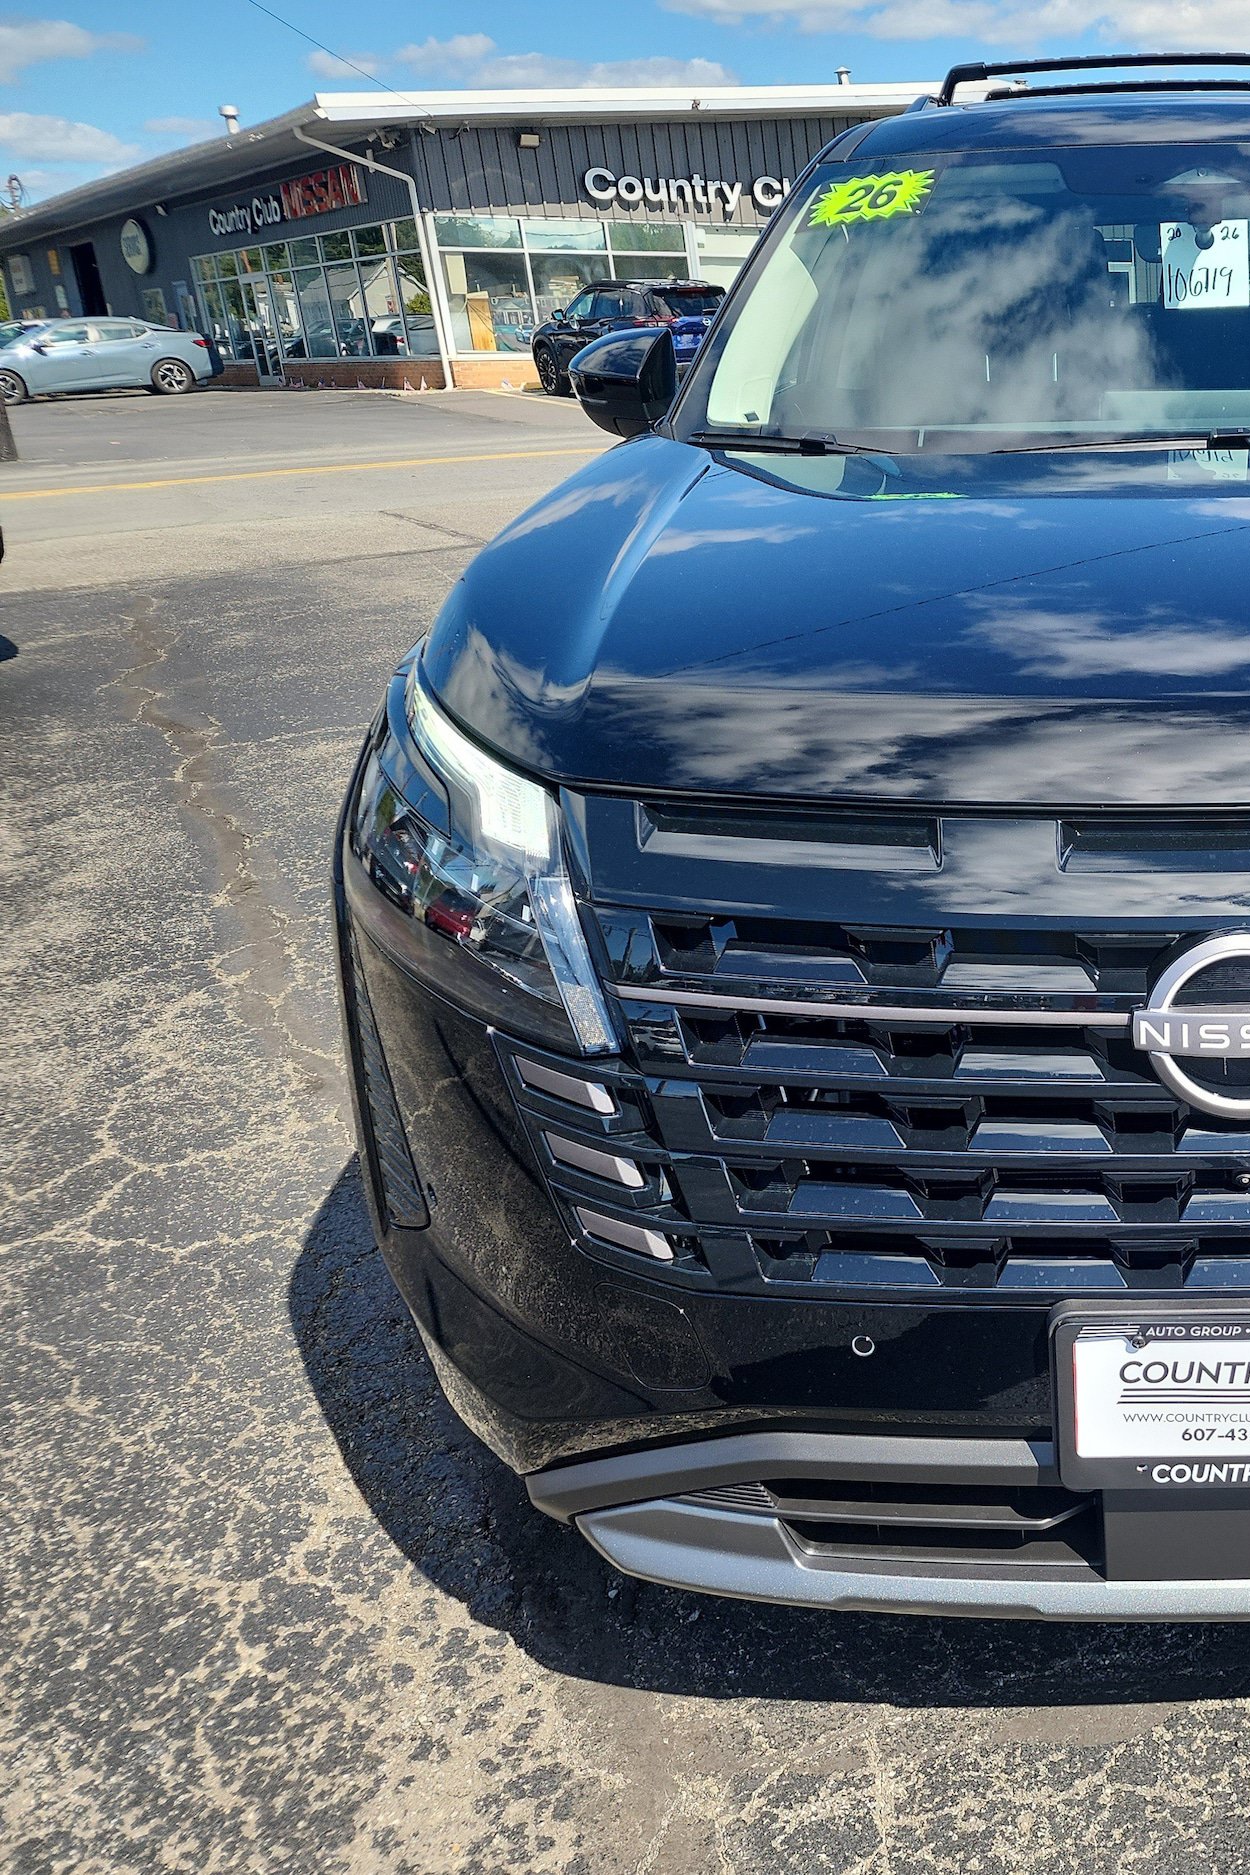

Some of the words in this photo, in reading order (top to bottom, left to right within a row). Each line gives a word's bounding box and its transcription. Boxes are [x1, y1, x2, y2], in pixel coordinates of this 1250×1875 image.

[208, 204, 252, 236] Country
[251, 194, 282, 227] Club
[279, 163, 362, 220] NISSAN
[584, 167, 742, 211] Country
[835, 179, 904, 215] 26
[1166, 227, 1182, 241] 20
[1220, 225, 1240, 241] 26
[1167, 263, 1233, 303] 106719
[1145, 1327, 1186, 1337] AUTO
[1190, 1326, 1242, 1336] GROUP
